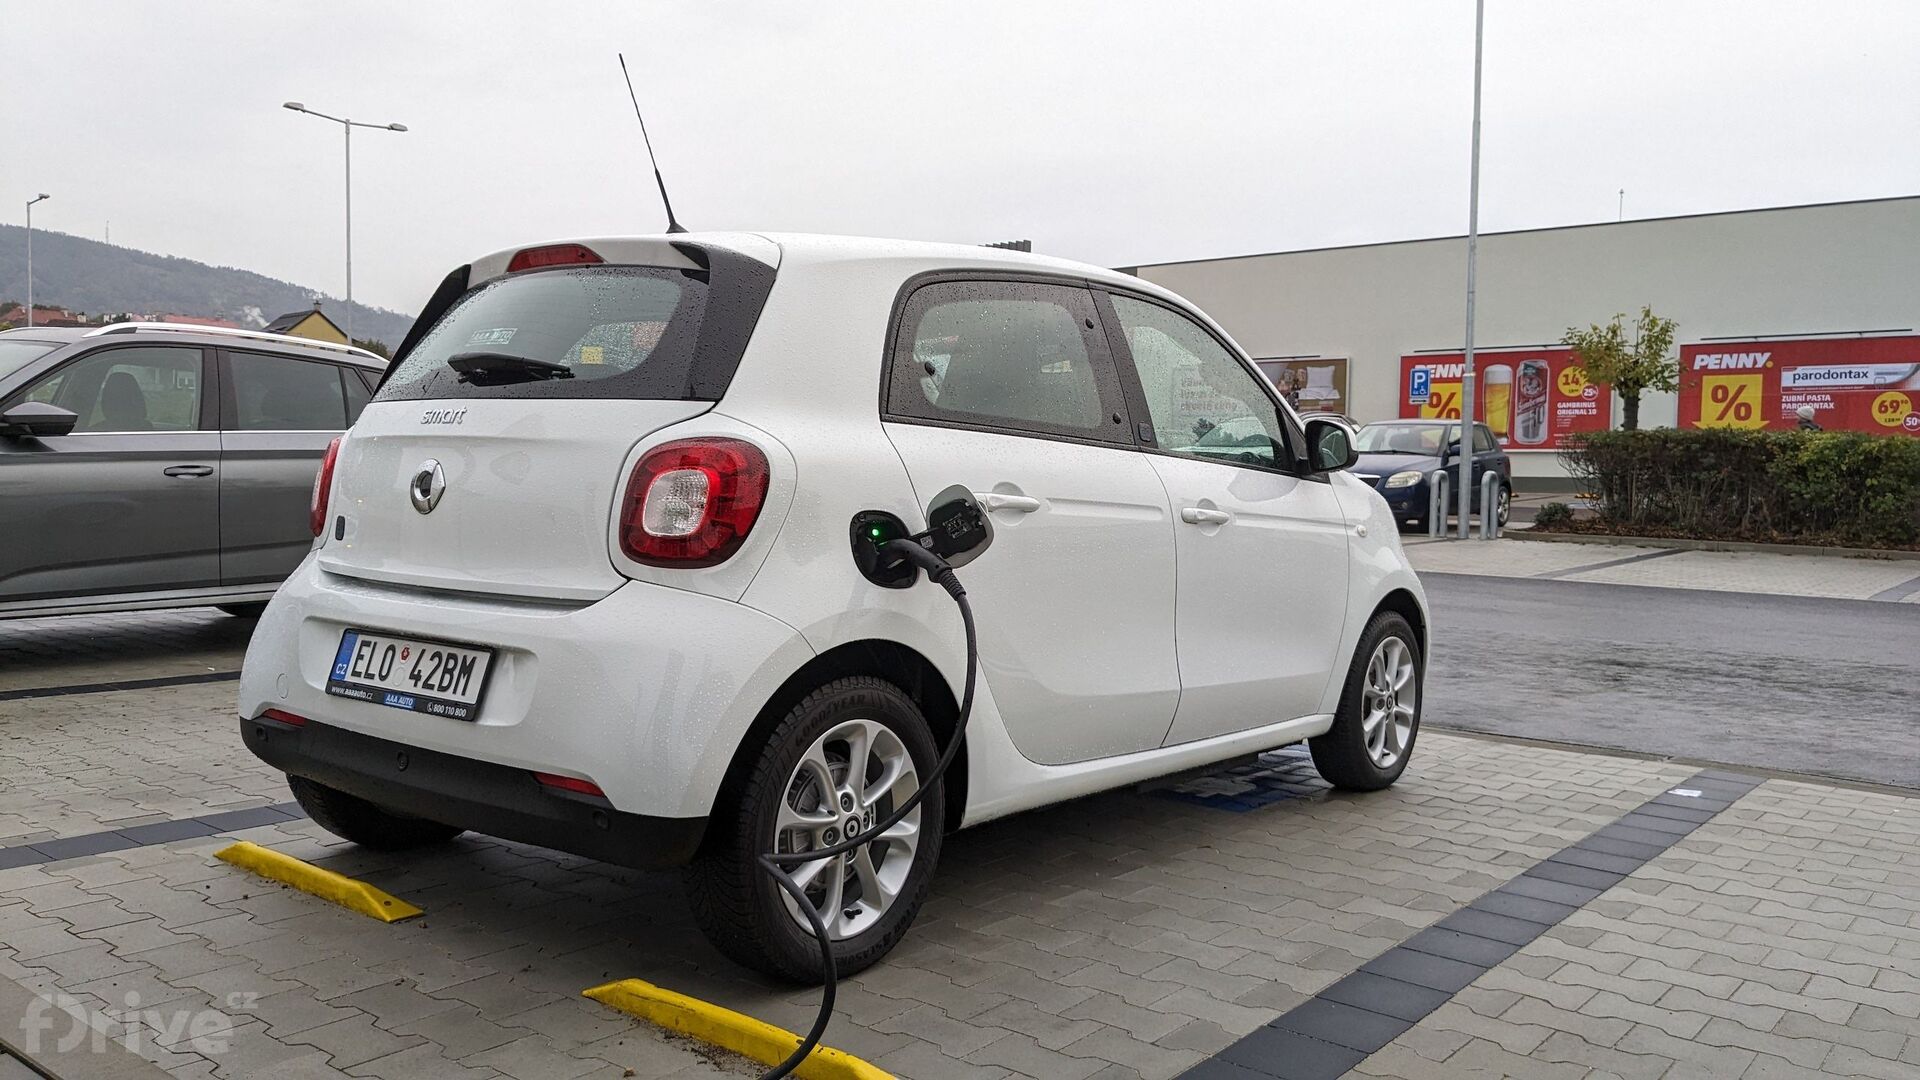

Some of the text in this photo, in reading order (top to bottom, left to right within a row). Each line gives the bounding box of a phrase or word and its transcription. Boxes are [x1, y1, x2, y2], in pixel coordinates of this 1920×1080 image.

[1414, 372, 1426, 389] P
[1793, 369, 1869, 384] parodontax
[1782, 394, 1806, 402] ZUBNÍ
[420, 405, 468, 425] smart
[1905, 417, 1920, 426] 50
[336, 664, 347, 675] CZ
[408, 648, 478, 697] 42BM
[331, 686, 467, 718] www.aaaauto.cz AAA AUTO 800 110 800
